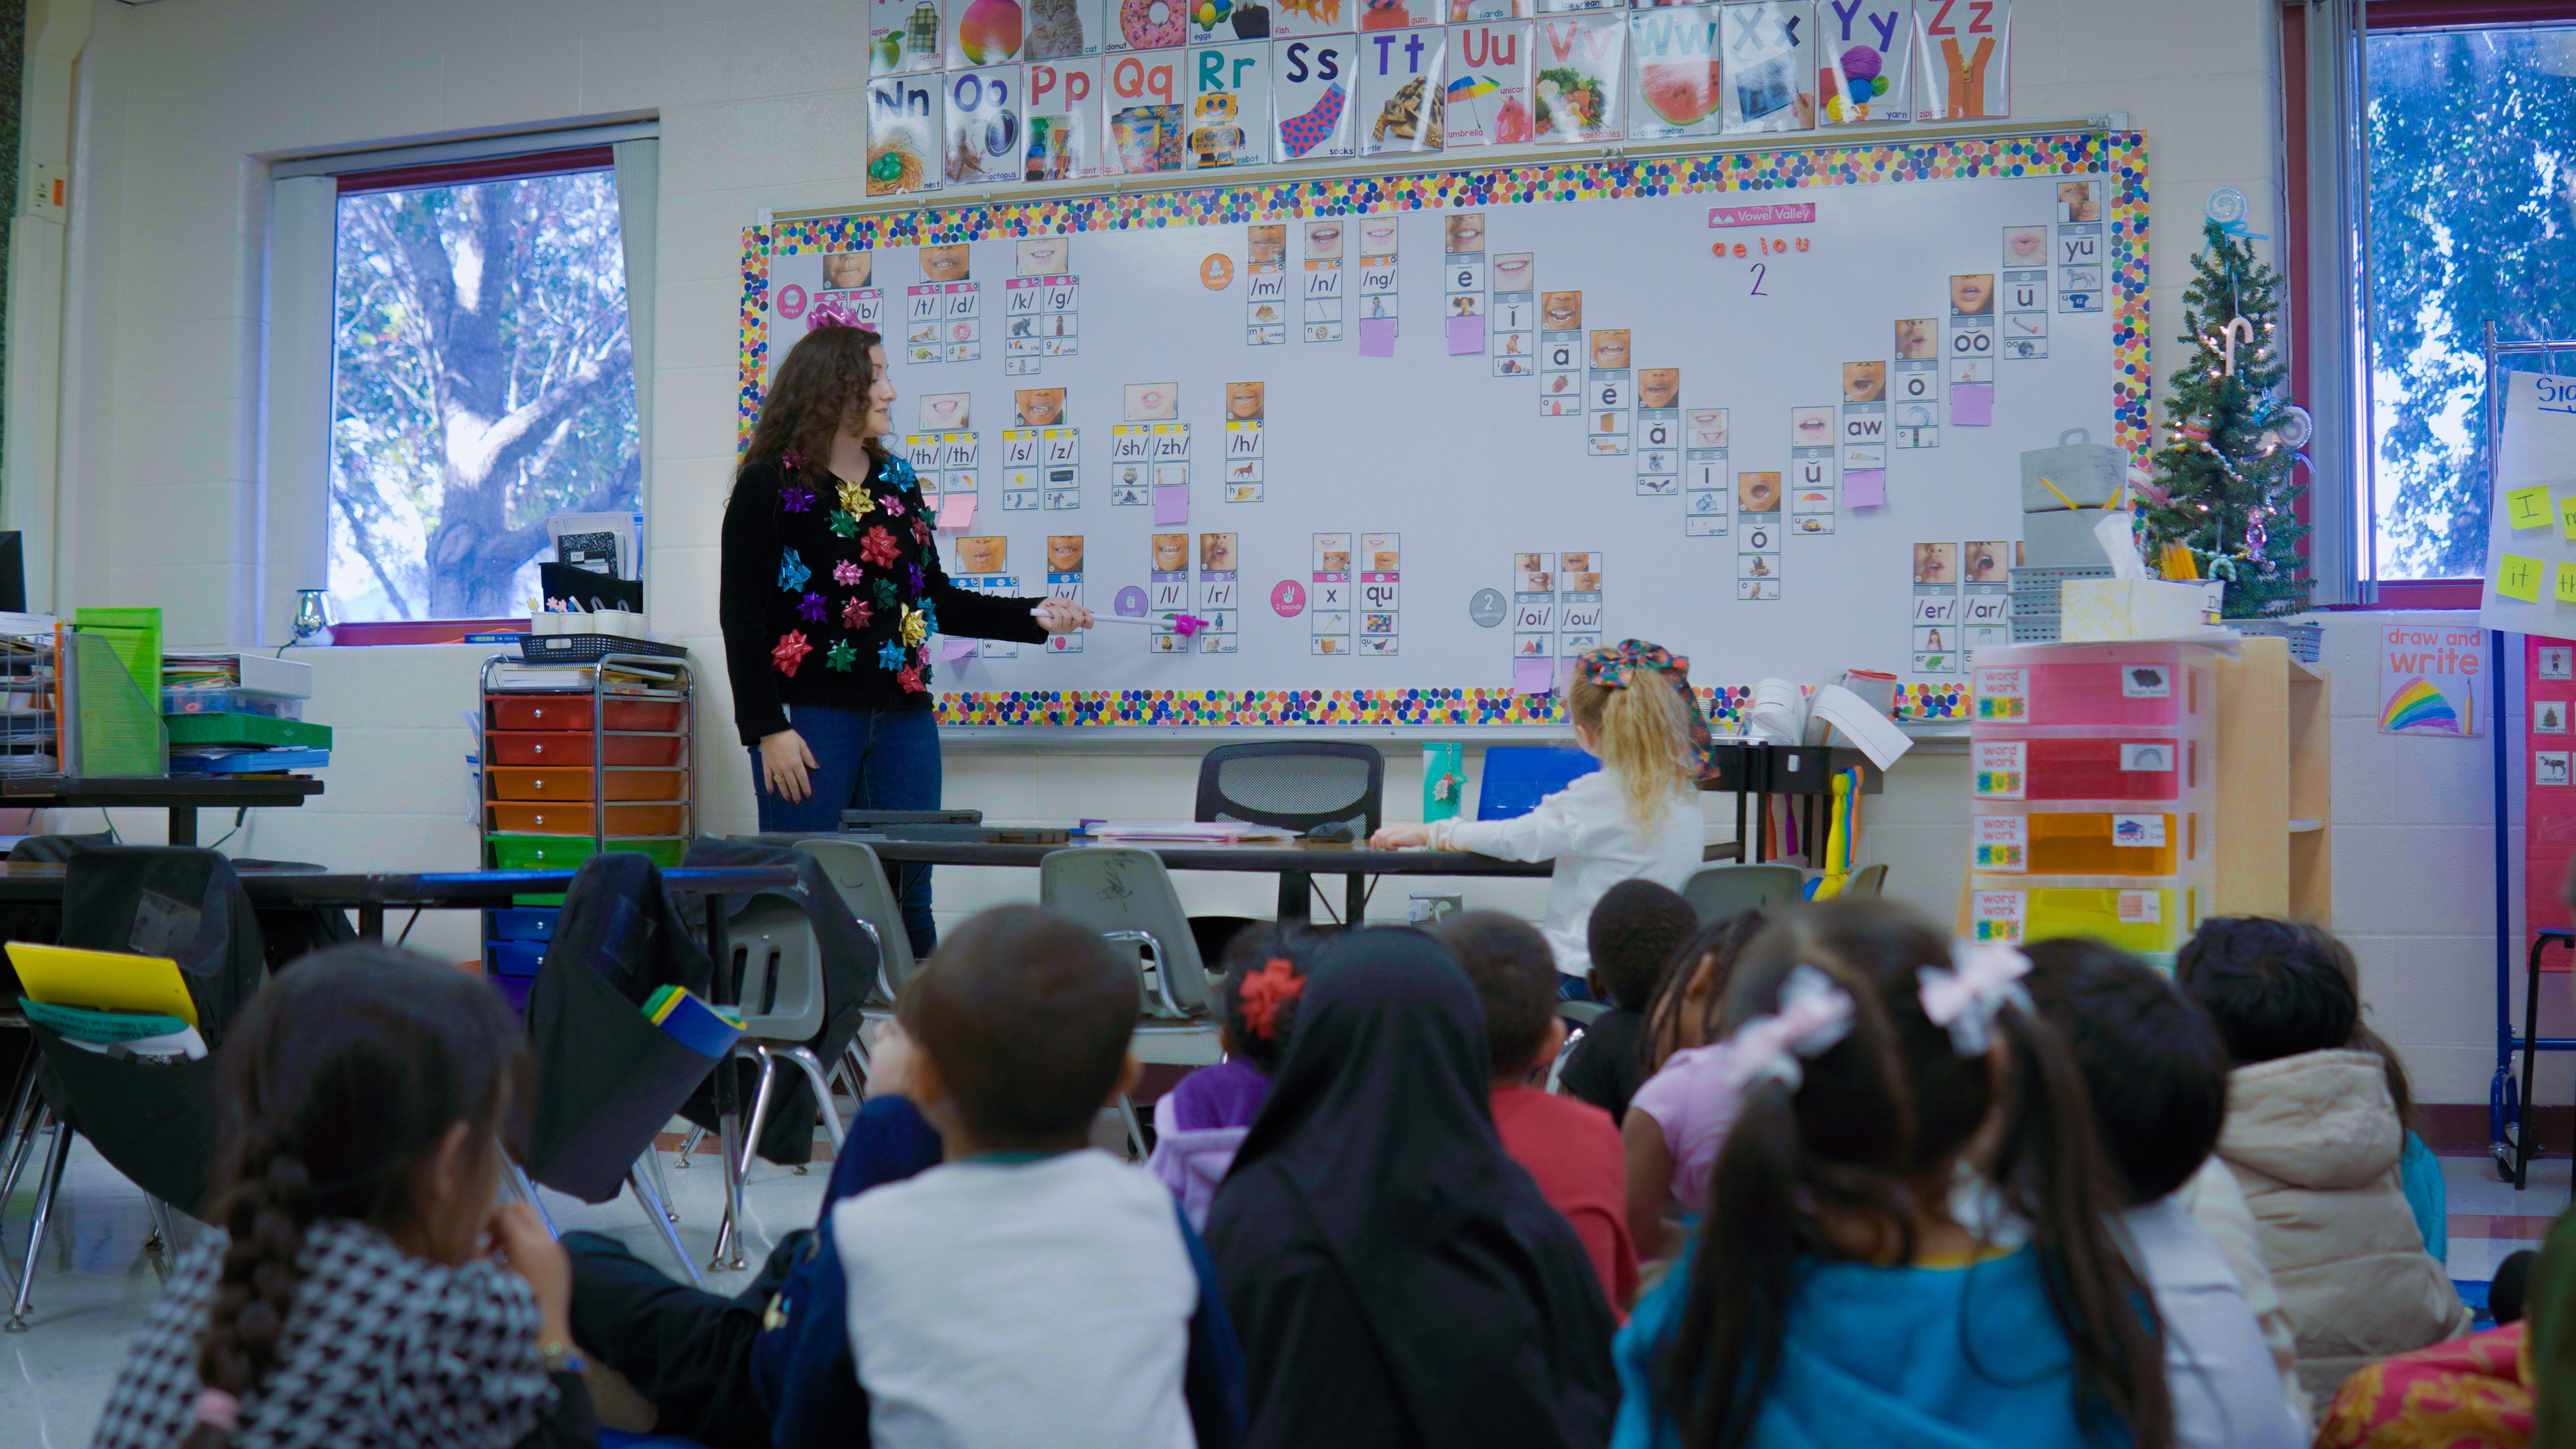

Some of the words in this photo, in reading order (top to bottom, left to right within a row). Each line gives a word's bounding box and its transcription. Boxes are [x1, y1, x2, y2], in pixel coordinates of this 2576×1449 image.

[1411, 17, 1427, 25] gum
[1480, 9, 1503, 18] hands
[872, 28, 889, 36] apple
[1106, 42, 1127, 51] donut
[1373, 34, 1424, 76] Tt
[1463, 27, 1516, 67] Uu
[920, 53, 940, 61] apron
[1286, 43, 1338, 83] Ss
[1199, 50, 1256, 91] Rr
[1886, 112, 1907, 120] yarn
[1449, 129, 1483, 137] umbrella
[1632, 127, 1684, 136] watermelon
[1726, 124, 1750, 132] x-ray
[1237, 155, 1258, 163] robot
[988, 171, 1017, 181] octopus
[1105, 165, 1120, 173] quilt
[1738, 210, 1771, 222] Vowel
[1775, 208, 1809, 221] Valley
[1712, 242, 1725, 257] a
[1733, 243, 1747, 257] e
[1759, 237, 1768, 255] i
[1773, 238, 1786, 252] o
[1795, 237, 1809, 252] u
[1251, 276, 1283, 296] /m/
[1311, 273, 1337, 292] /n/
[1363, 269, 1395, 289] /ng/
[1750, 263, 1768, 296] 2
[914, 297, 934, 316] /t/
[950, 295, 974, 315] /d/
[1012, 291, 1034, 310] /k/
[1048, 287, 1074, 309] /g/
[1848, 420, 1882, 436] aw
[1011, 443, 1032, 461] /s/
[1050, 441, 1073, 460] /z/
[1115, 438, 1148, 457] /sh/
[1154, 437, 1189, 456] /zh/
[1233, 434, 1258, 453] /h/
[2516, 494, 2540, 518] I
[2512, 563, 2529, 587] it
[1208, 585, 1230, 603] /r/
[1327, 589, 1337, 603] x
[1367, 586, 1393, 607] qu
[1484, 594, 1494, 612] 2
[1518, 607, 1551, 626] /oi/
[1916, 599, 1955, 619] /er/
[1966, 598, 2006, 618] /ar/
[1563, 609, 1600, 626] /ou/
[1361, 638, 1371, 646] qu
[2389, 628, 2439, 646] draw
[2446, 631, 2481, 646] and
[2391, 648, 2479, 675] write
[1986, 671, 2019, 681] word
[1986, 682, 2019, 693] work
[1984, 746, 2017, 755] word
[1984, 757, 2017, 767] work
[1984, 818, 2016, 828] word
[1984, 830, 2016, 840] work
[1983, 893, 2016, 903] word
[1983, 905, 2015, 915] work
